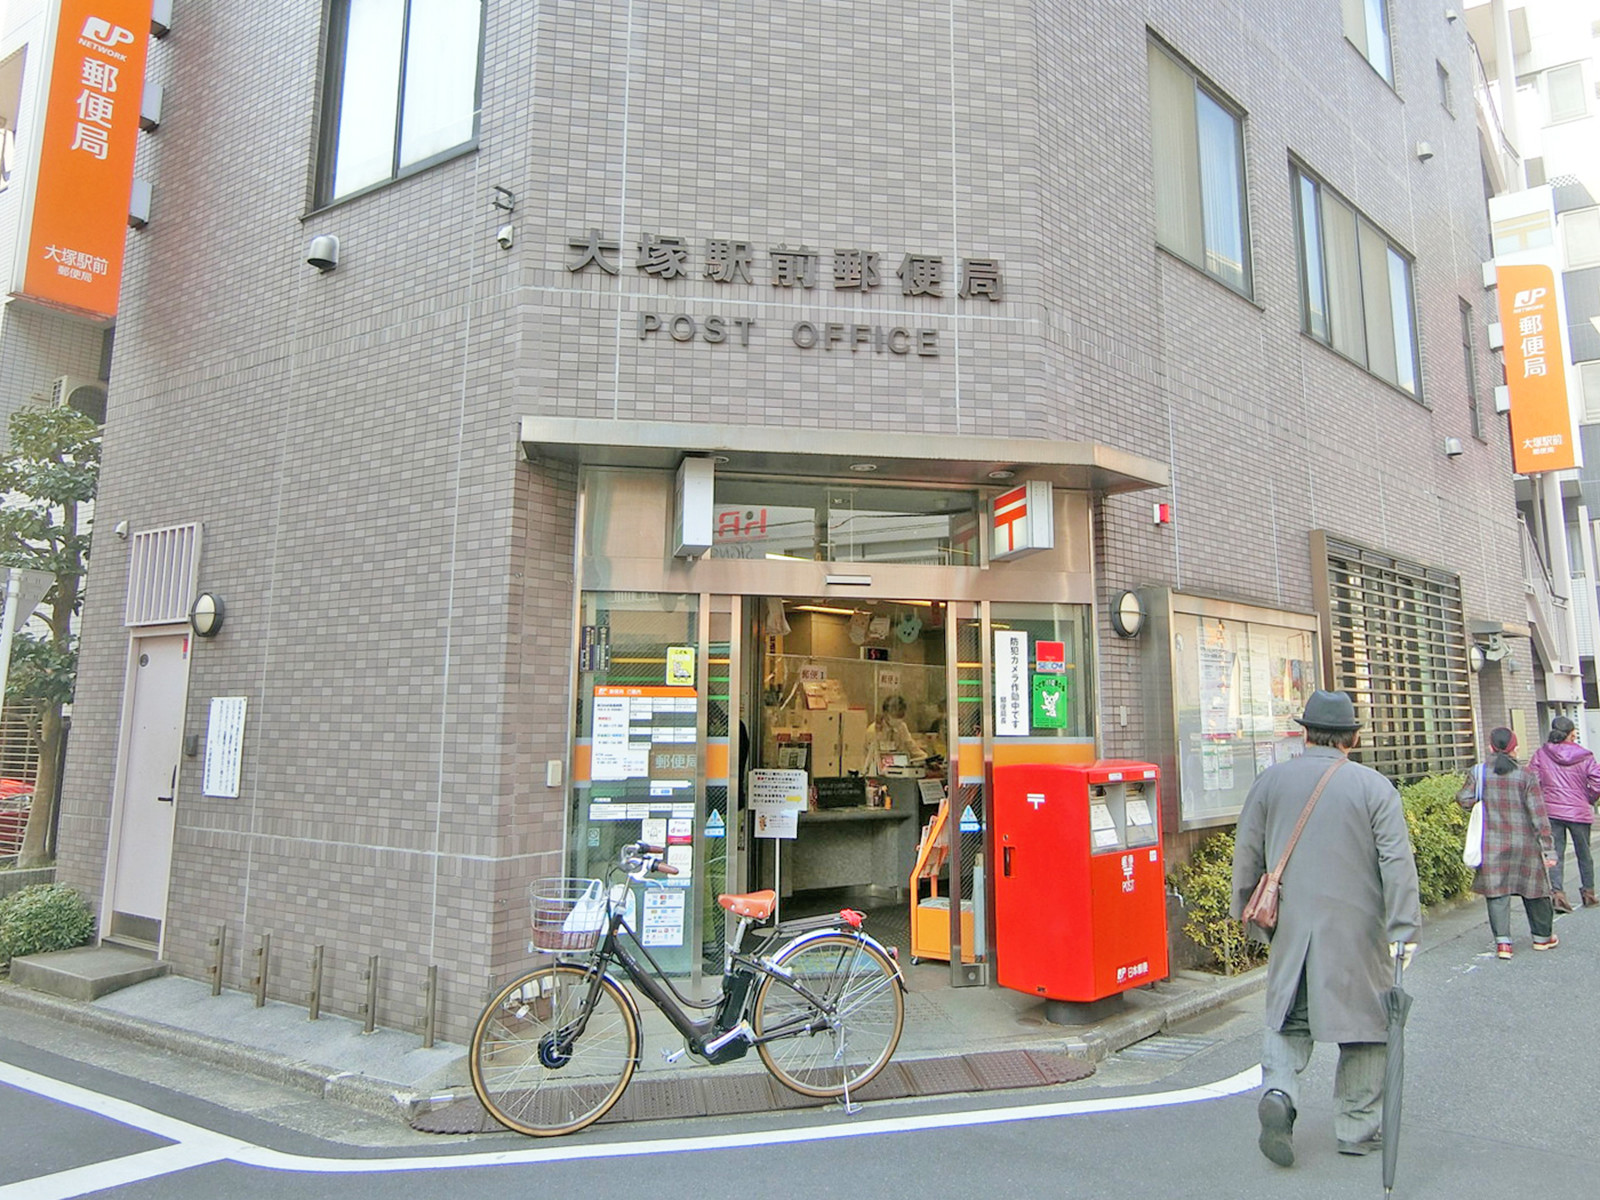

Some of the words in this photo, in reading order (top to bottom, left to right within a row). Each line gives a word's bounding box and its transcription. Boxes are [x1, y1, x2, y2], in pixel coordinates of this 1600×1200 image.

[78, 37, 127, 62] NETWORK
[82, 16, 135, 47] JP
[71, 57, 119, 160] 郵便局
[43, 244, 109, 276] 大塚駅前
[566, 228, 1004, 302] 大塚駅前郵便局
[639, 311, 755, 346] POST
[792, 320, 940, 357] OFFICE
[1518, 314, 1547, 379] 郵便局
[1010, 636, 1020, 729] 防犯カメラ作動中です
[656, 753, 697, 769] 郵便局
